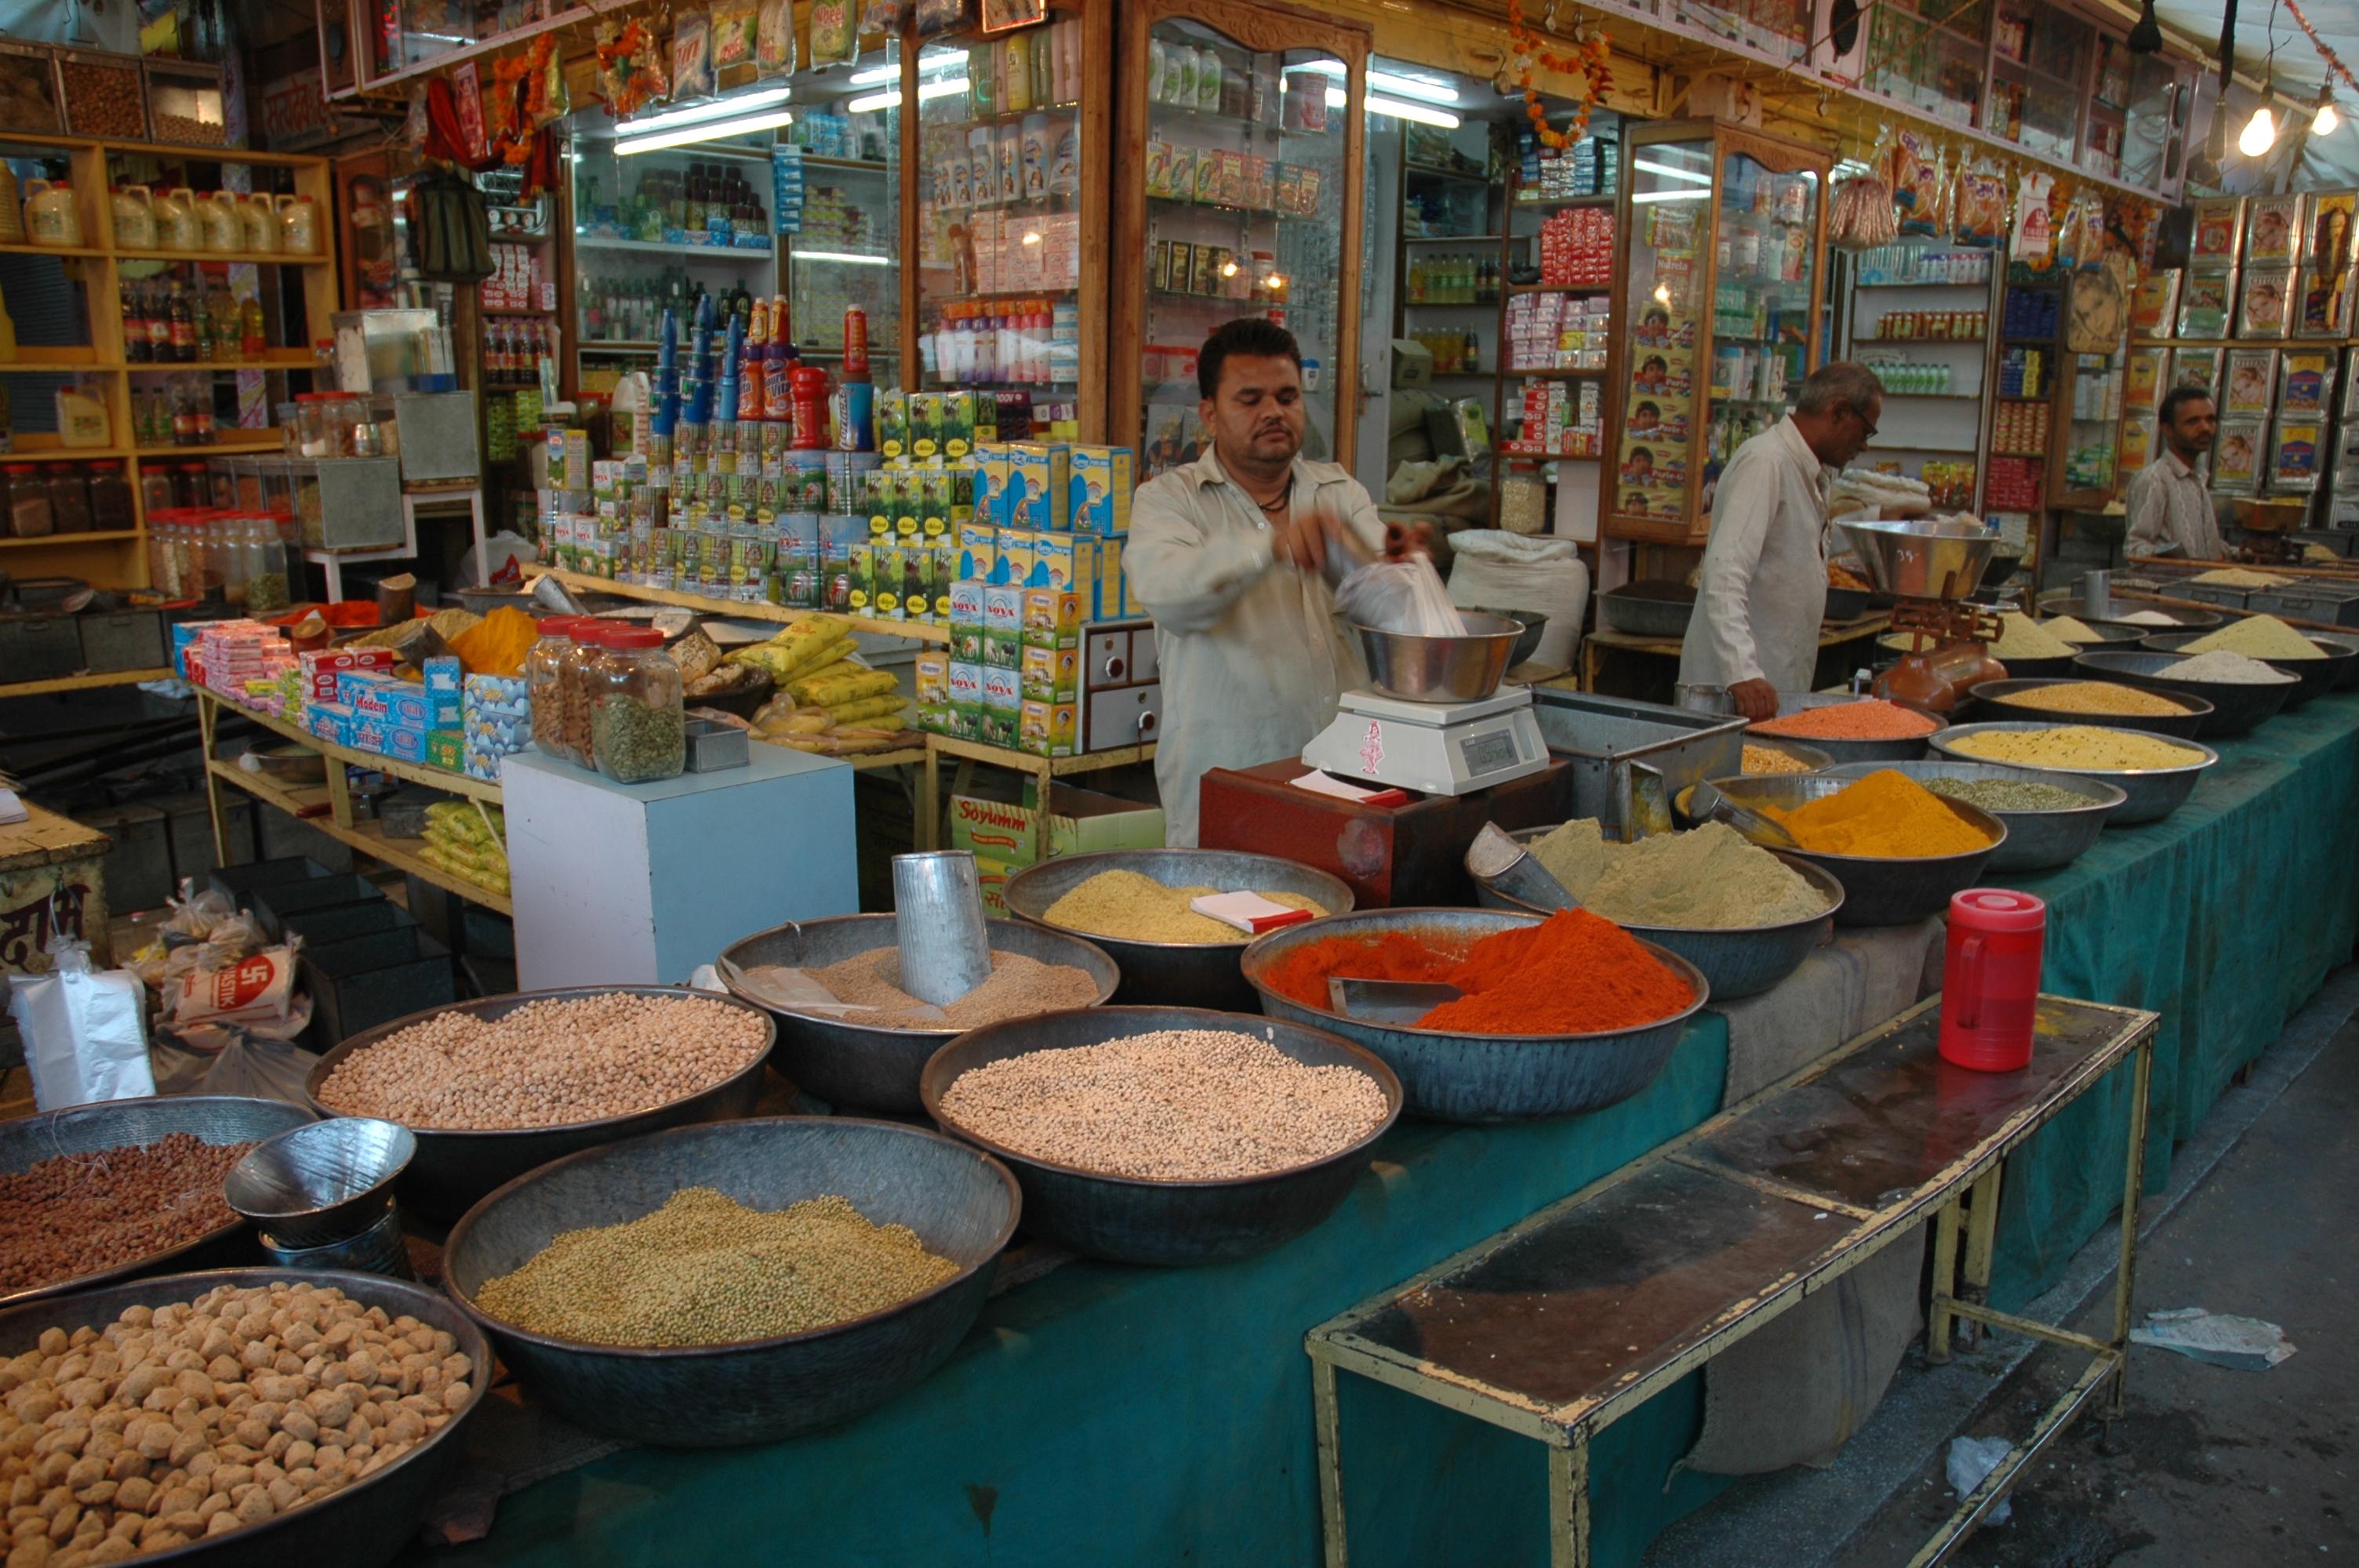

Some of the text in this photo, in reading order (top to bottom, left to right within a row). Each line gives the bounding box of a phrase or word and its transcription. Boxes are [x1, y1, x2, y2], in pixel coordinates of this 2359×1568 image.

[814, 3, 845, 26] Wheel
[1657, 260, 1689, 271] Nutrela
[2250, 274, 2286, 285] CITIZEN
[2234, 358, 2267, 368] CITIZEN
[772, 381, 791, 398] Vita
[2222, 426, 2256, 436] CITIZEN
[1652, 470, 1685, 481] Parle-G
[952, 601, 977, 612] NOVA
[987, 605, 1015, 618] NOVA
[951, 677, 977, 689] NOVA
[986, 682, 1013, 696] NOVA
[355, 695, 387, 713] Modern
[958, 800, 1025, 833] Soyumm
